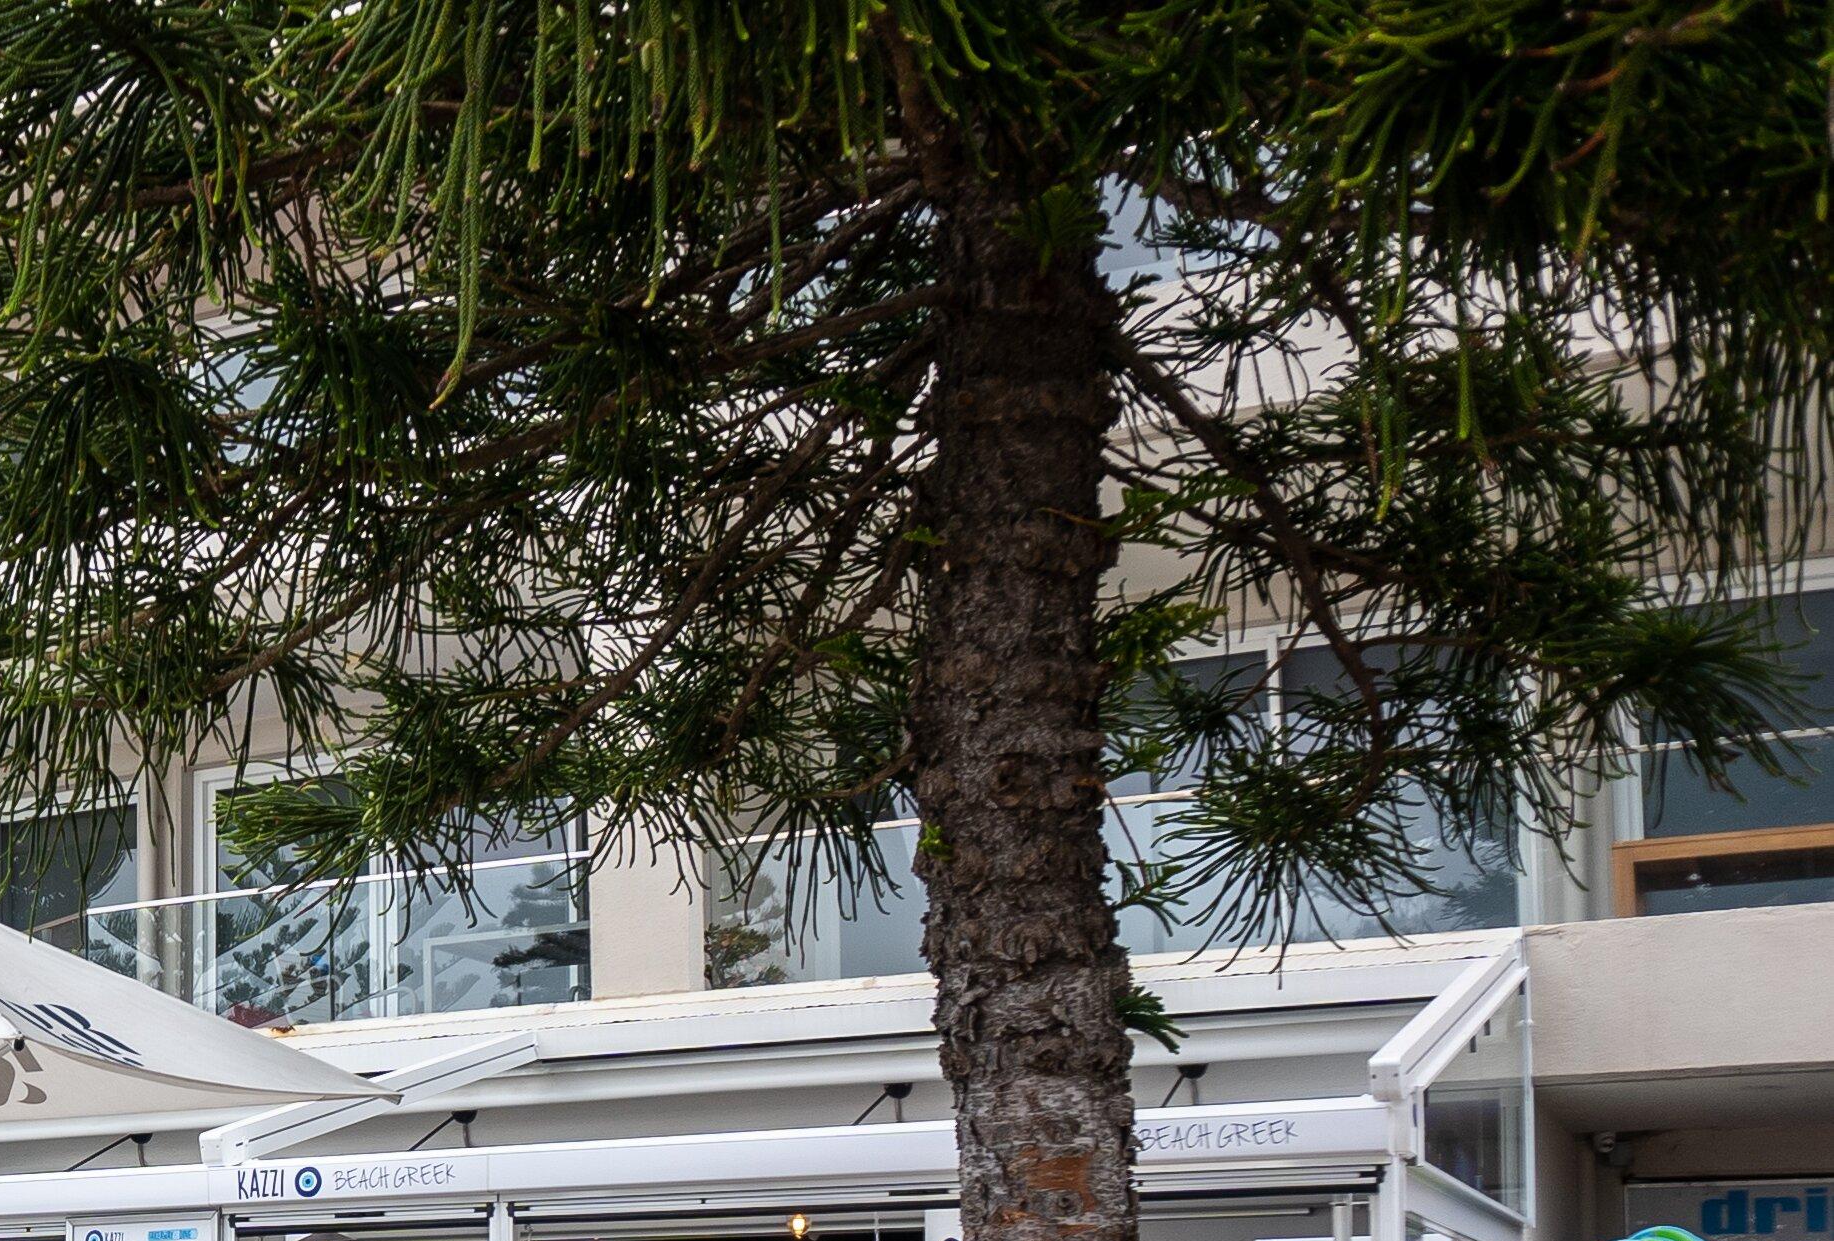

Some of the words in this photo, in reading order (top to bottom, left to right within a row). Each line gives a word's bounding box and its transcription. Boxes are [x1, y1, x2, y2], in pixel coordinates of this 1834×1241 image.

[1138, 1122, 1213, 1151] BEACH
[1216, 1119, 1299, 1149] GREEK
[237, 1169, 285, 1200] KAZZI
[333, 1165, 389, 1191] BEACH
[393, 1163, 457, 1189] GREEK
[1700, 1186, 1834, 1240] dri
